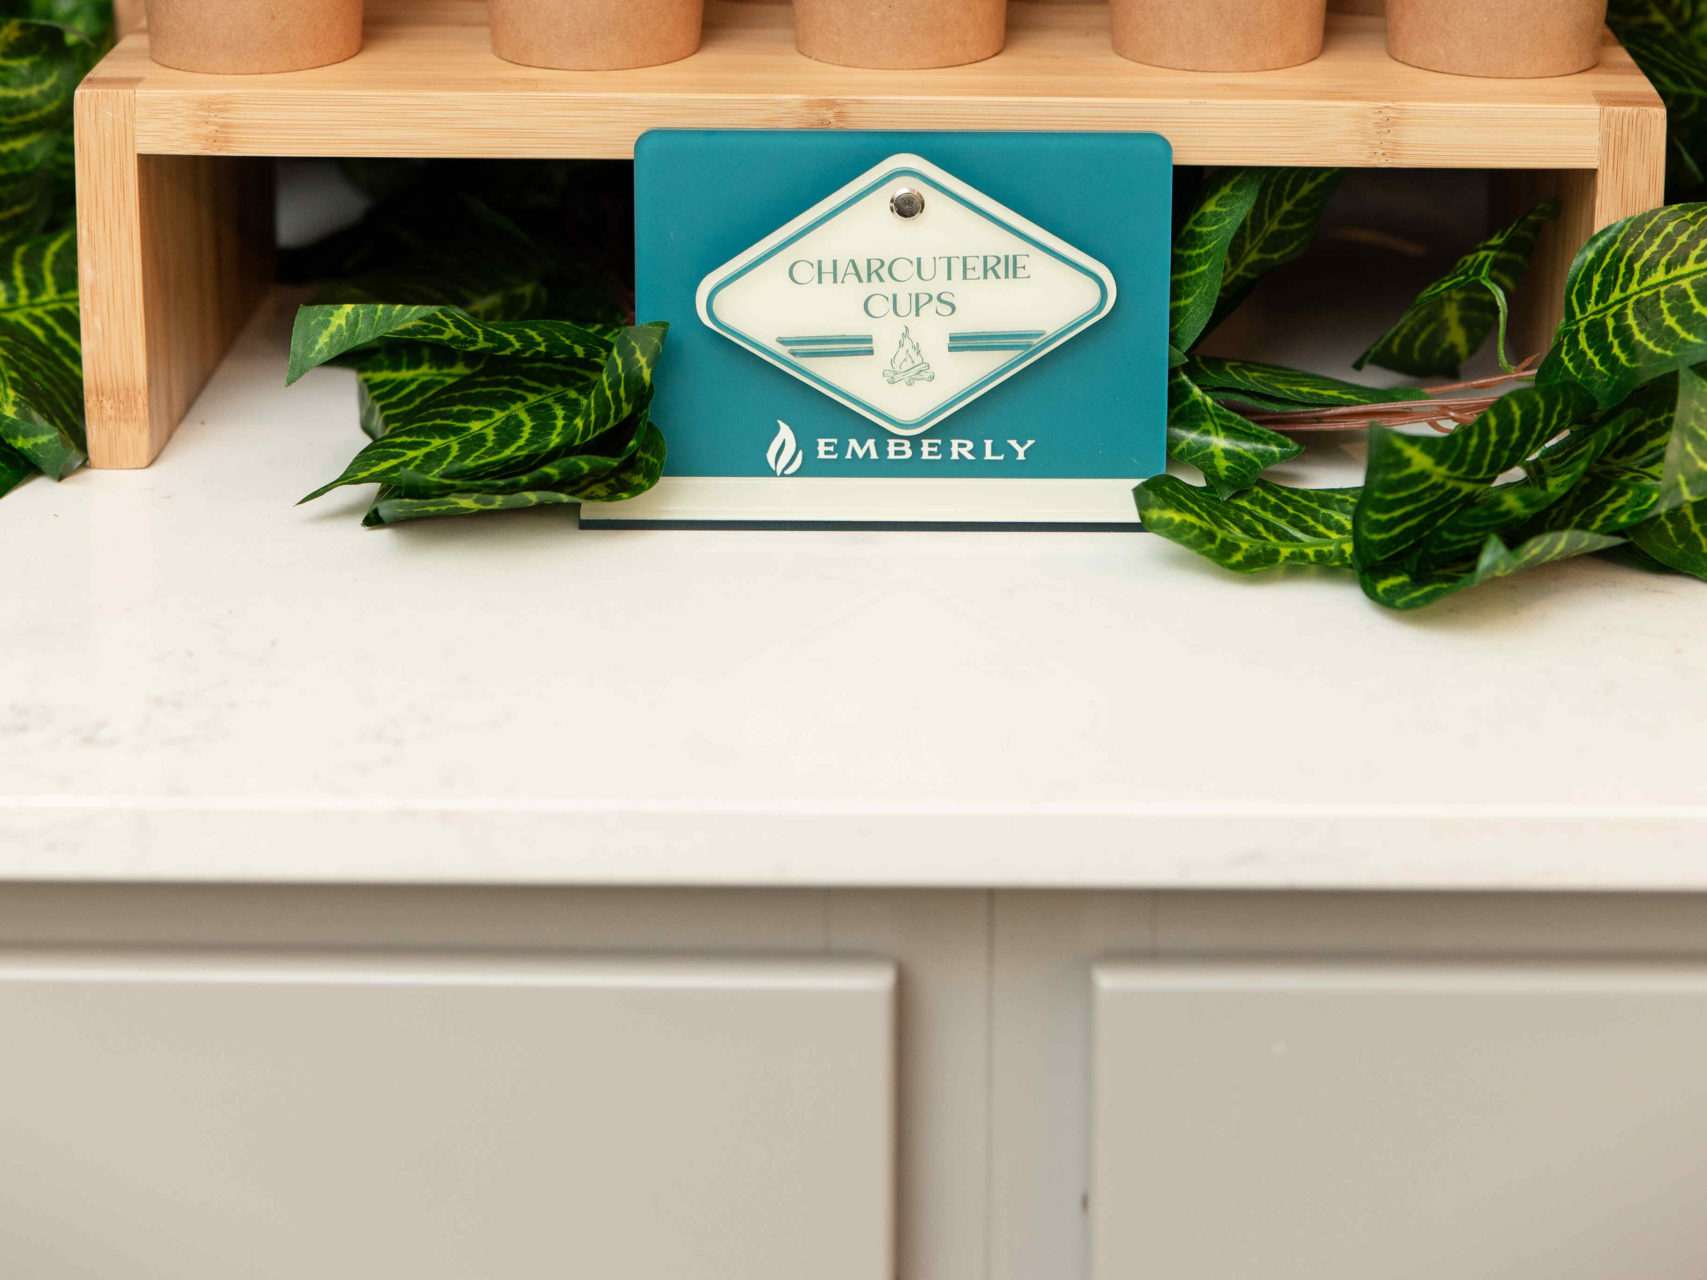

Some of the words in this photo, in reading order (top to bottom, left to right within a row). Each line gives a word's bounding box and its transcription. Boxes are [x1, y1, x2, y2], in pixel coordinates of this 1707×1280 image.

[788, 253, 1031, 285] CHARCUTERIE
[862, 290, 957, 319] CUPS
[815, 437, 1037, 461] EMBERLY
